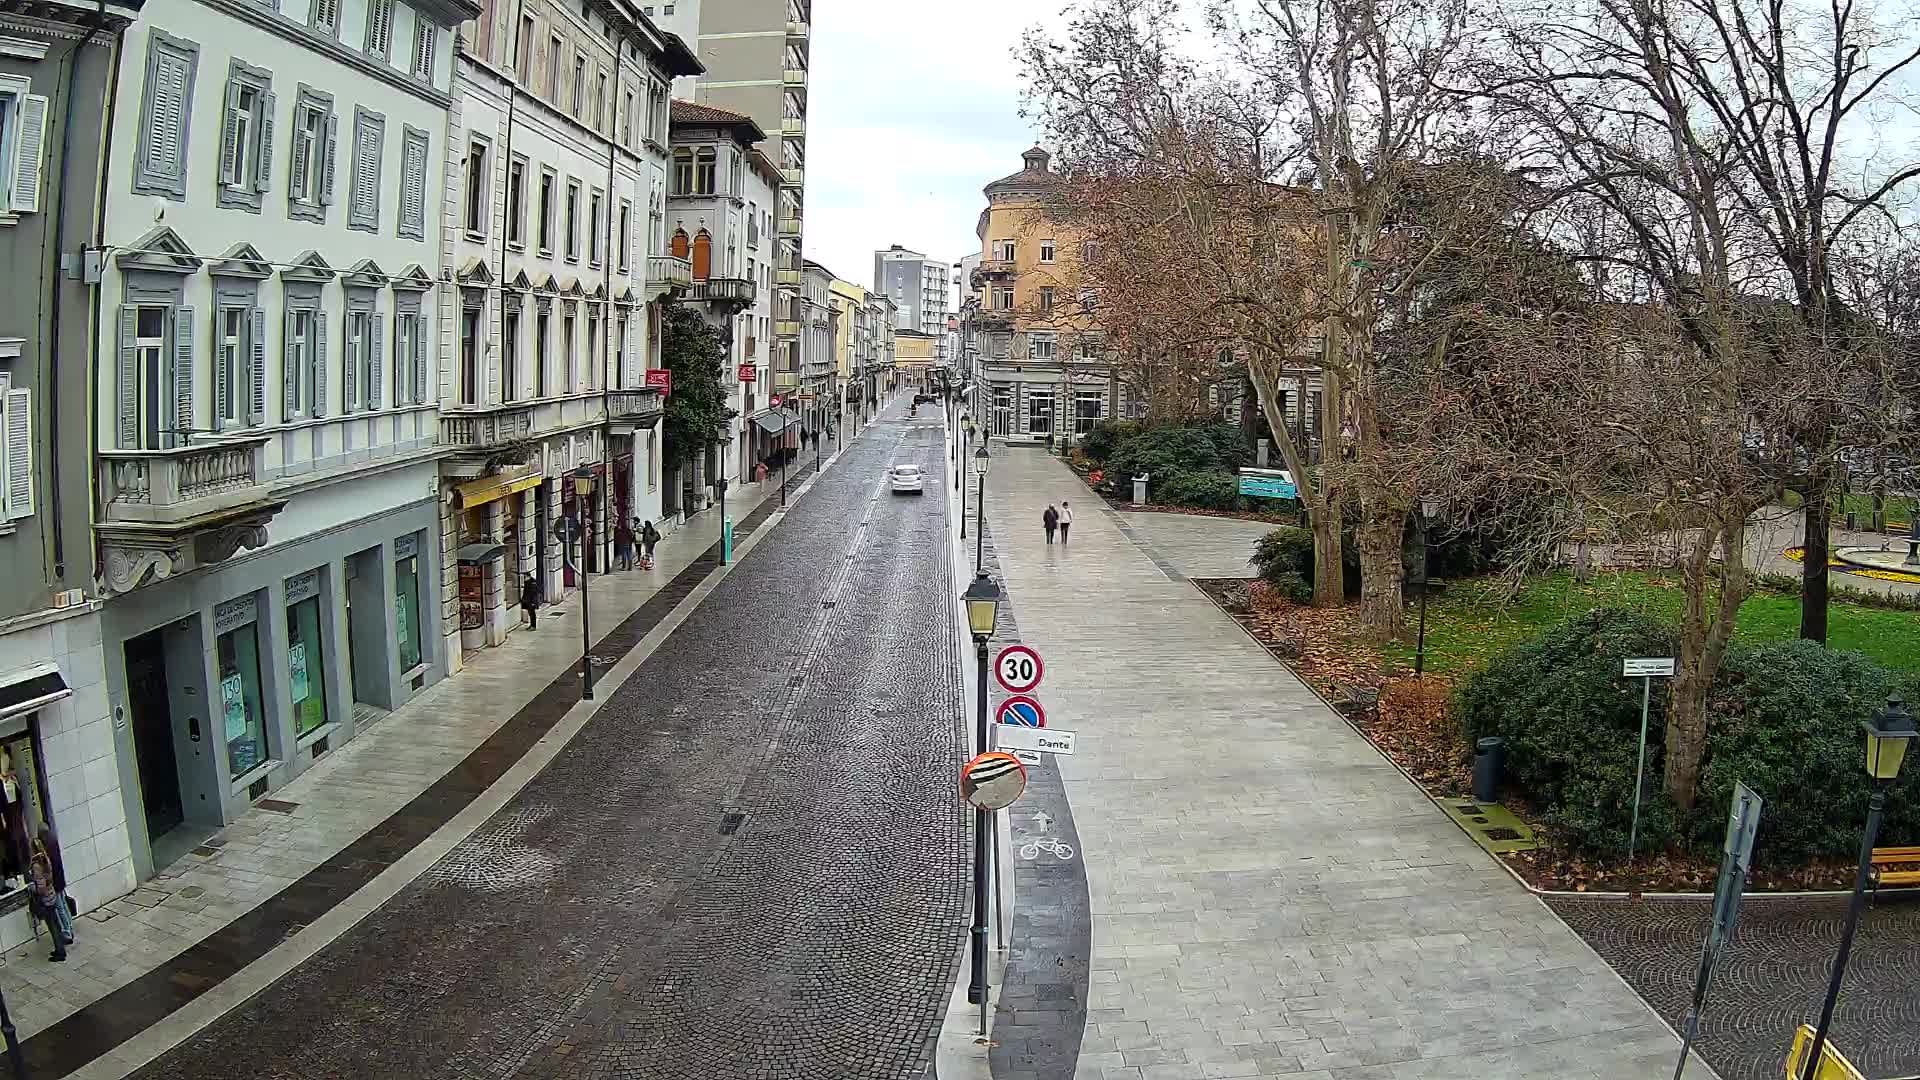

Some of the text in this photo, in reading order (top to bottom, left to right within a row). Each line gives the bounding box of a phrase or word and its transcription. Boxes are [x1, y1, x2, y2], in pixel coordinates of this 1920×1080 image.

[1005, 659, 1033, 680] 30
[222, 677, 241, 700] 130
[1038, 738, 1070, 749] Dante
